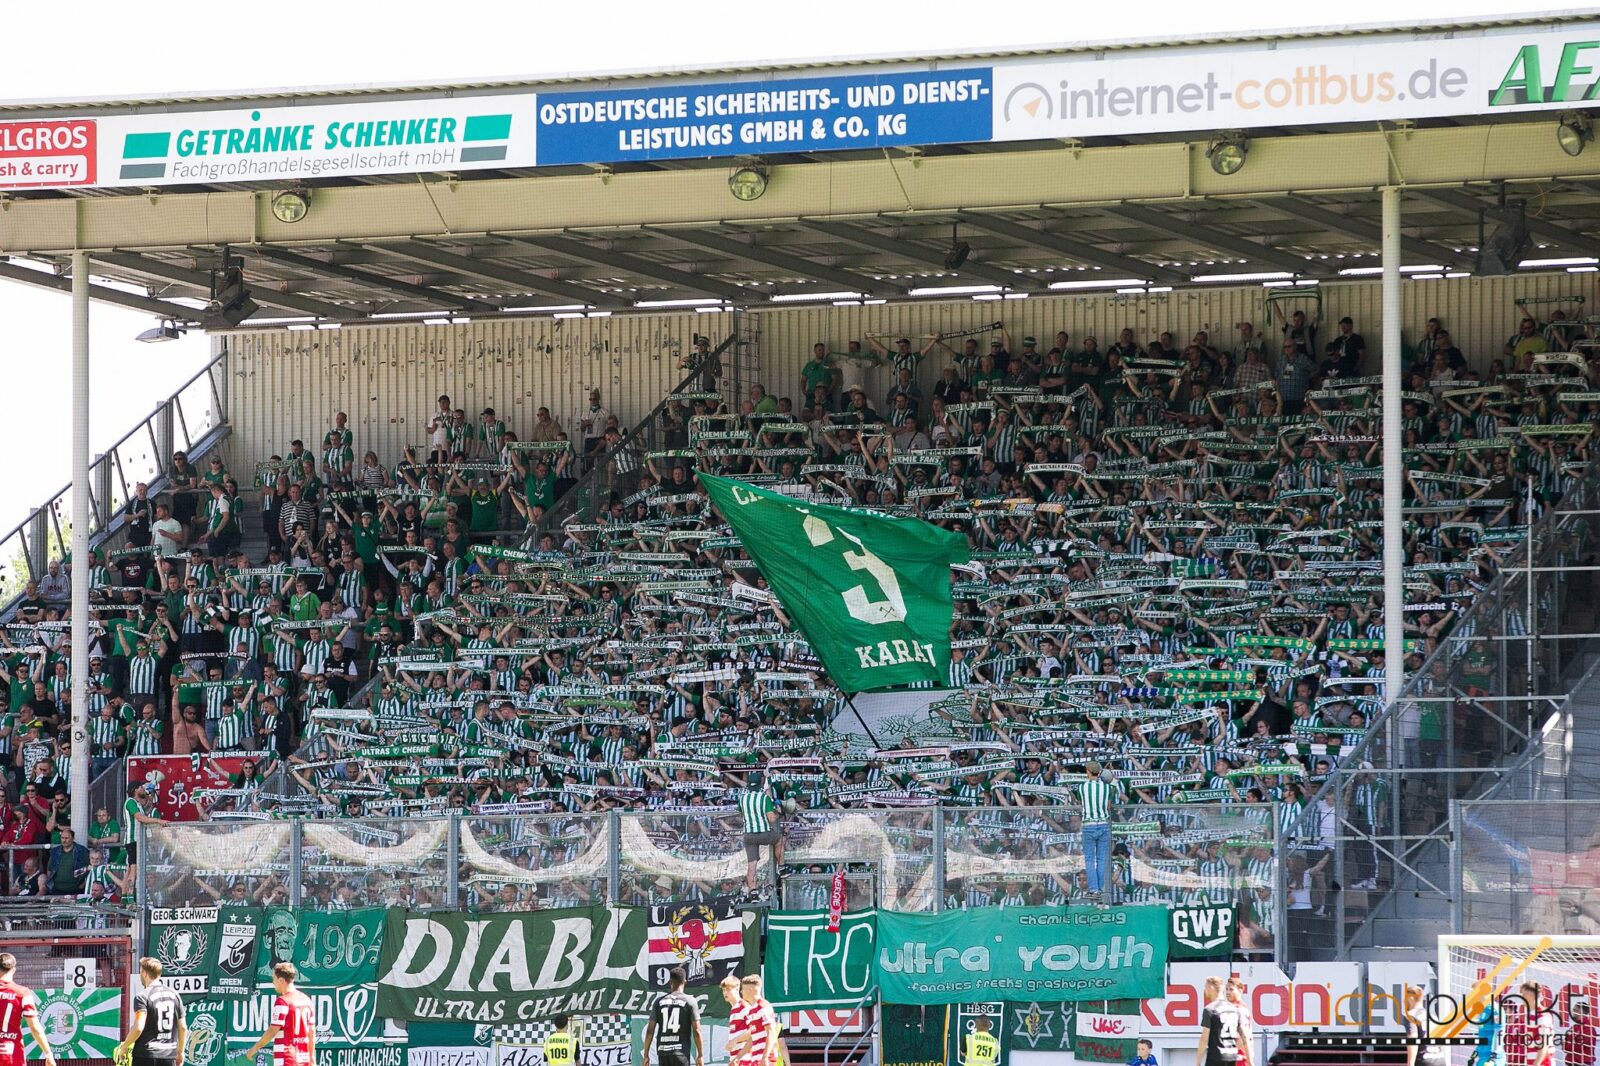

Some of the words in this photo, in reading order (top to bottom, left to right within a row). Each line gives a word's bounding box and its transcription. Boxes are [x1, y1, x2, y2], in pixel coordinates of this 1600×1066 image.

[1489, 40, 1600, 106] AF
[1059, 57, 1468, 120] internet-cottbus.de
[540, 97, 688, 126] OSTDEUTSCHE
[694, 87, 840, 117] SICHERHEITS-
[846, 84, 896, 109] UND
[902, 79, 990, 104] DIENST-
[323, 116, 457, 151] SCHENKER
[619, 122, 733, 152] LEISTUNGS
[739, 118, 805, 144] GMBH
[810, 116, 826, 140] &
[832, 115, 869, 138] CO.
[876, 113, 907, 136] KG
[172, 151, 411, 180] Fachgroßhandelsgesellschaft
[415, 147, 456, 166] mbH
[21, 162, 33, 176] &
[36, 163, 79, 178] carry
[699, 430, 729, 440] CHEMIE
[730, 428, 751, 439] FANS
[1130, 429, 1158, 439] CHEMIE
[1160, 427, 1188, 437] LEIPZIG
[927, 511, 973, 520] VENCEREMOS
[1148, 520, 1199, 529] VENCEREMOS
[1115, 580, 1169, 588] VENCEREMOS
[1297, 594, 1312, 602] BSG
[1204, 601, 1258, 615] VENCEREMOS
[389, 655, 413, 663] CHEMIE
[412, 654, 437, 662] LEIPZIG
[1019, 676, 1049, 685] Chemie
[548, 687, 581, 697] CHEMIE
[584, 687, 605, 697] FANS
[210, 751, 224, 760] BSG
[225, 751, 247, 760] CHEMIE
[361, 748, 390, 757] ULTRAS
[401, 745, 430, 755] CHEMIE
[477, 748, 503, 758] CHEMIE
[392, 777, 420, 786] ULTRAS
[771, 773, 824, 783] VENCEREMOS
[828, 785, 842, 794] BSG
[843, 782, 867, 792] CHEMIE
[153, 909, 179, 922] GEORG
[179, 907, 217, 921] SCHWARZ
[1172, 908, 1233, 939] GWP
[224, 926, 255, 936] LEIPZIG
[768, 922, 873, 995] TRC
[726, 961, 740, 979] 7
[73, 965, 87, 988] 8
[219, 977, 243, 986] GREEN
[211, 985, 249, 995] BASTARDS
[414, 995, 507, 1022] ULTRAS
[966, 1003, 996, 1014] HBSG
[156, 999, 175, 1034] 13
[660, 1007, 681, 1033] 14
[338, 1047, 402, 1066] CUCARACHAS
[549, 1047, 568, 1060] 109
[976, 1044, 993, 1058] 251
